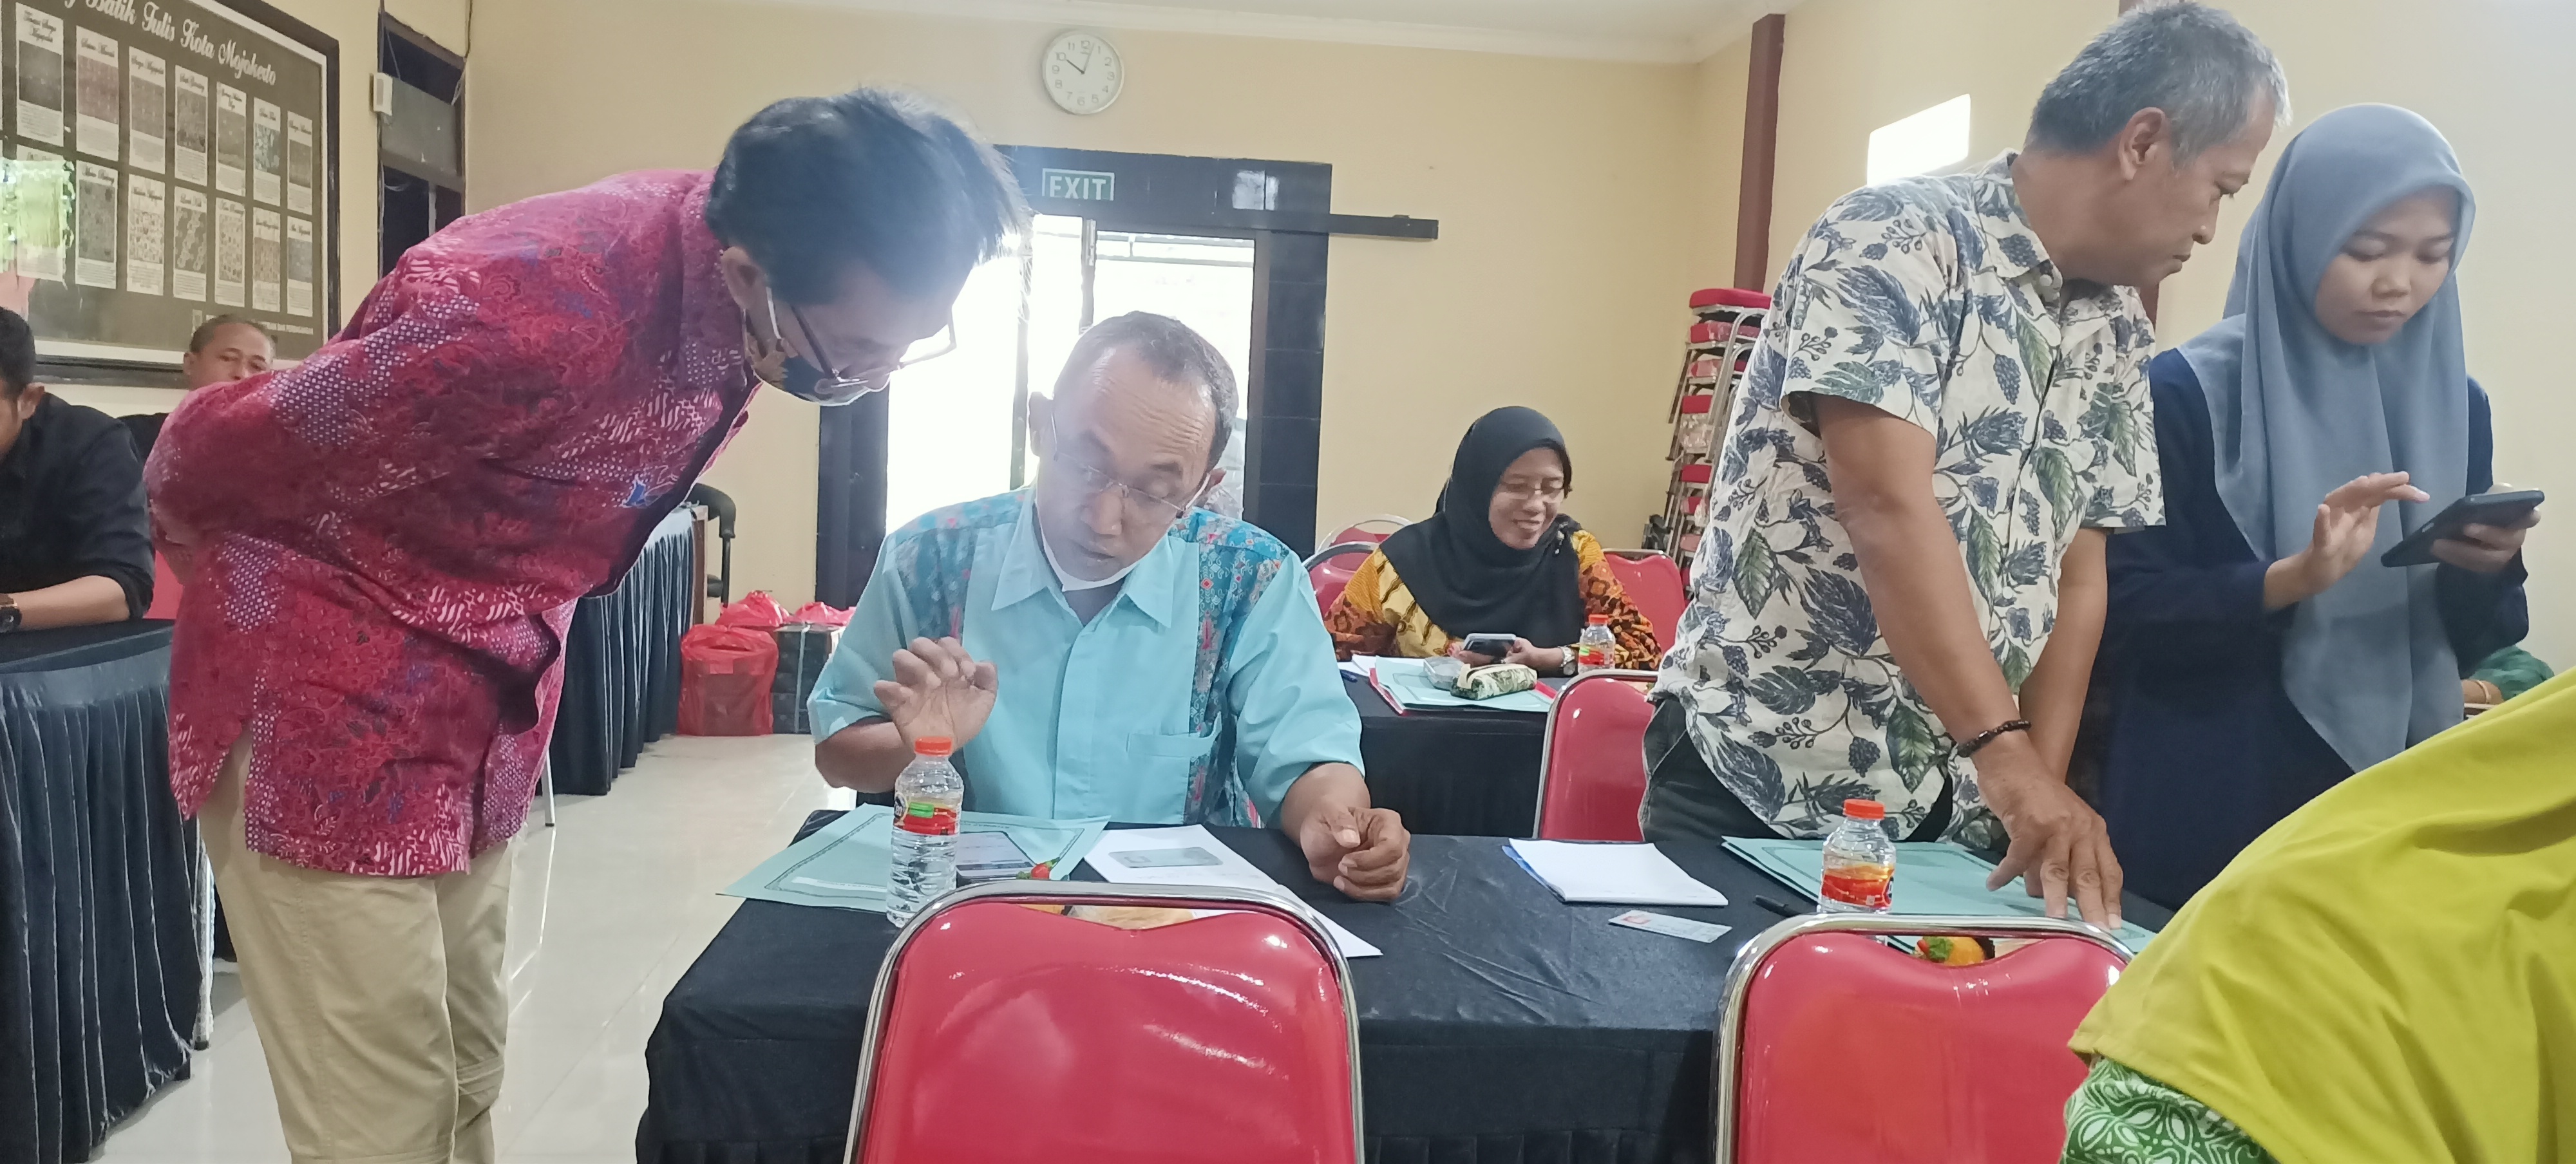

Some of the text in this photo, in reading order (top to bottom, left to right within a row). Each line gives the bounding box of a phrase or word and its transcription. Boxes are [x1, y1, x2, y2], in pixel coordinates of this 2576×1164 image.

[142, 1, 175, 41] Tulis
[180, 19, 215, 59] Kota
[1104, 56, 1112, 67] 2
[1106, 71, 1115, 81] 3
[1077, 96, 1085, 106] 6
[1050, 175, 1106, 200] EXIT
